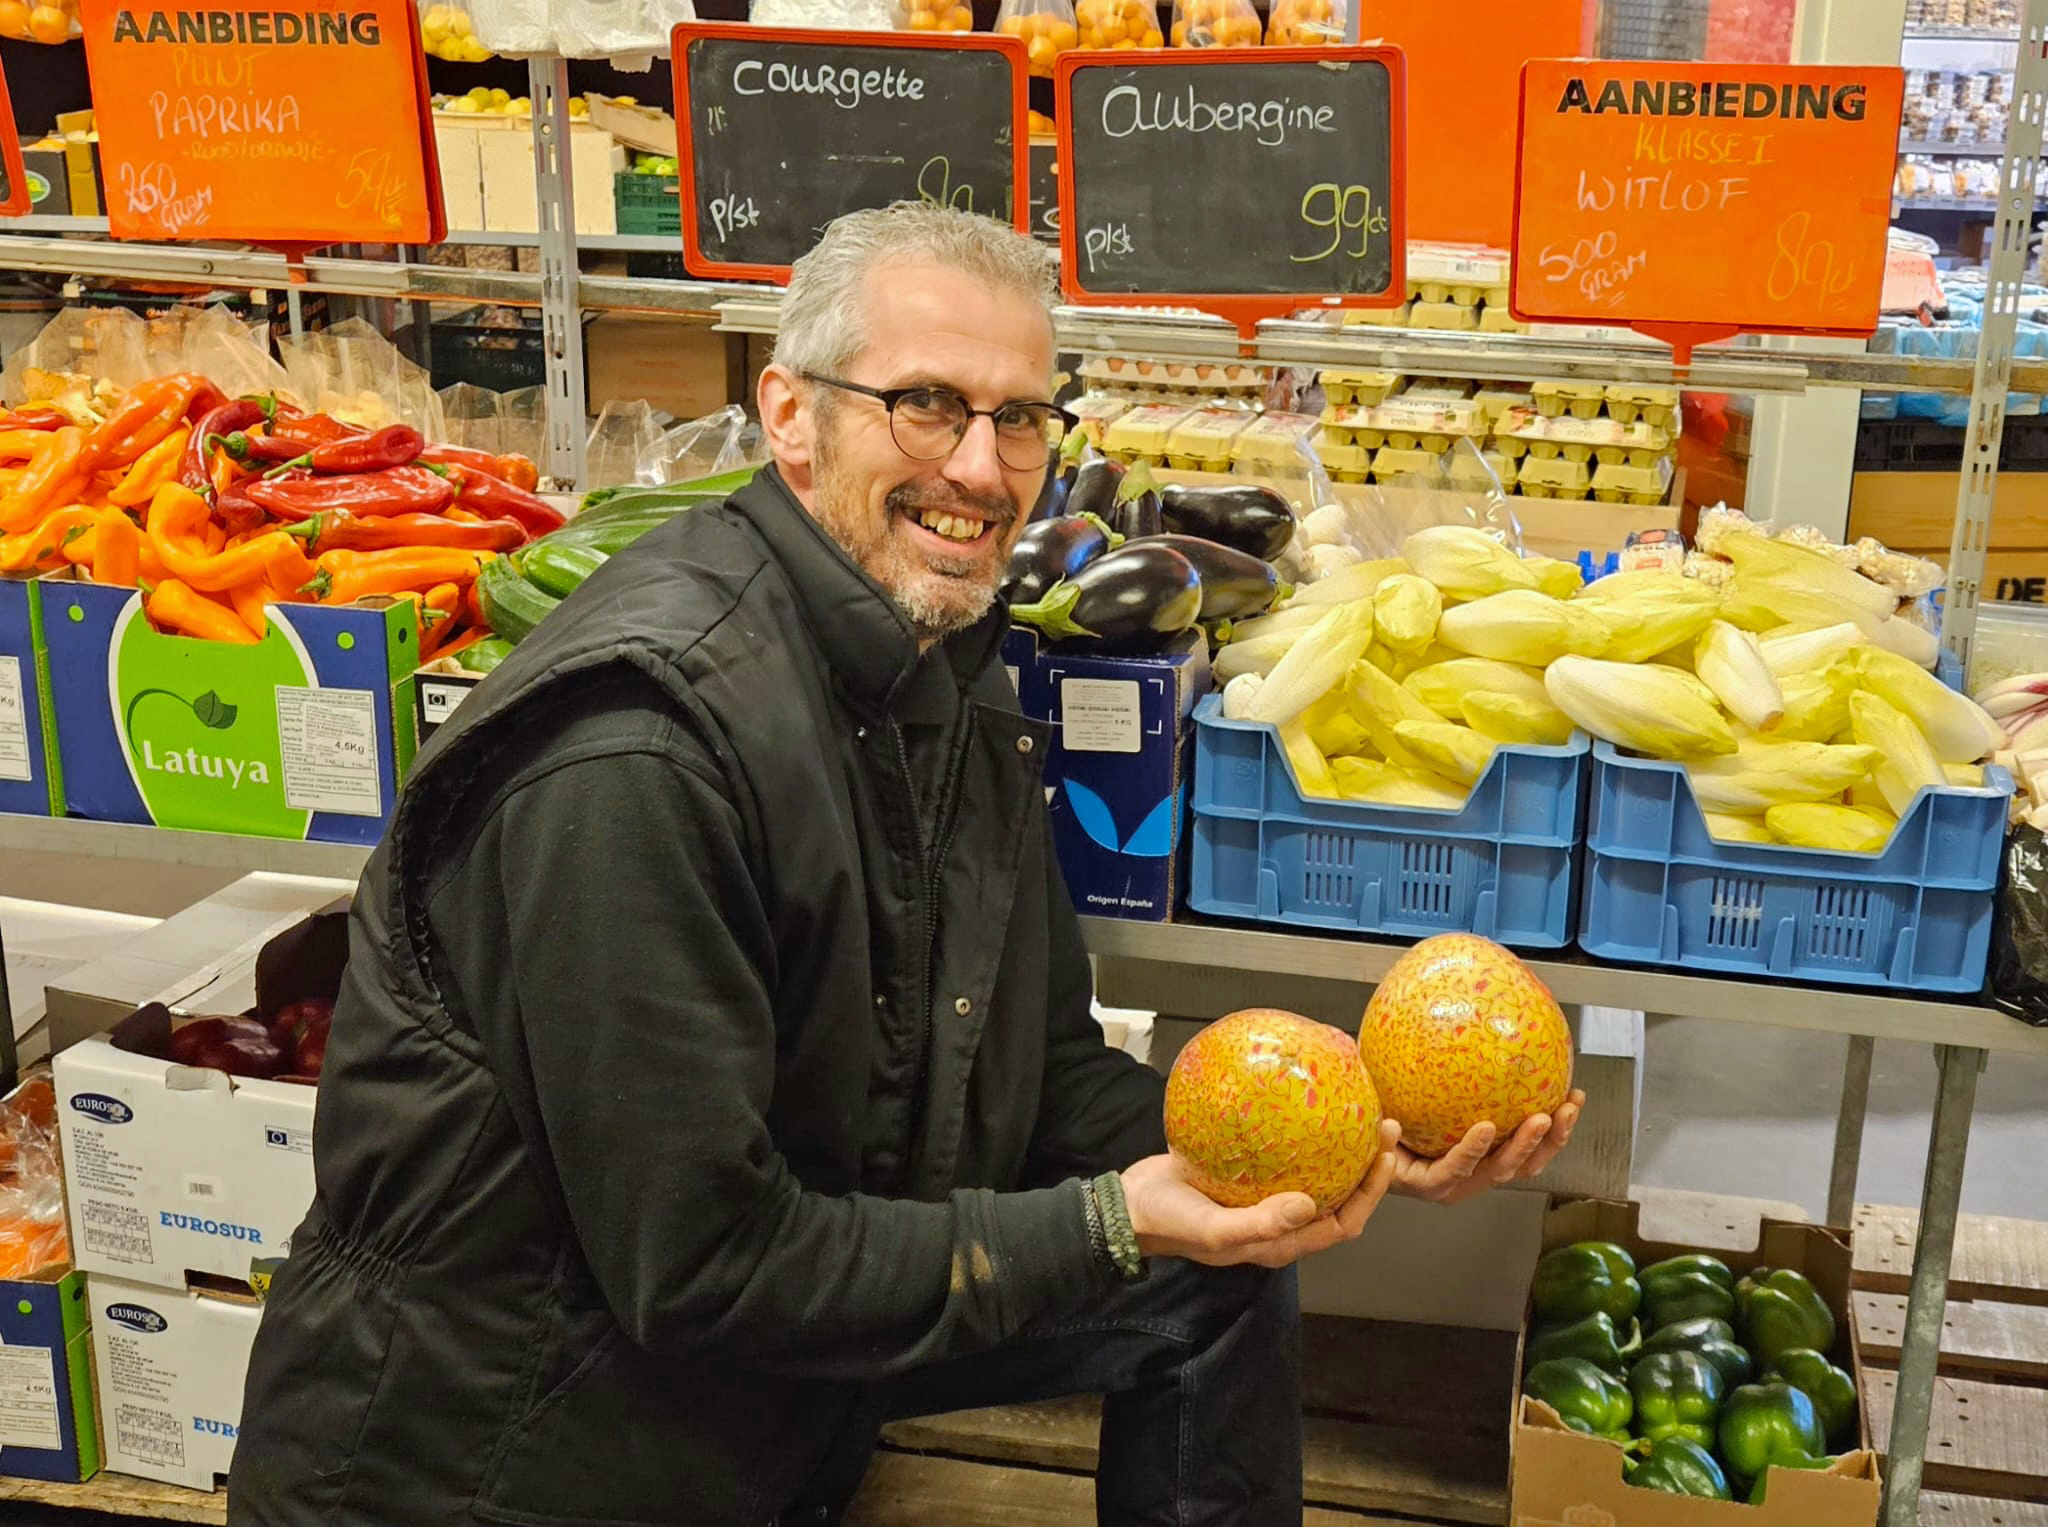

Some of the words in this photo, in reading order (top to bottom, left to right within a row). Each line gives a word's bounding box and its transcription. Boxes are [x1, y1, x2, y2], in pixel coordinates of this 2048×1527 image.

[113, 10, 380, 46] AANBIEDING
[150, 89, 300, 140] PAPRIKA
[1556, 78, 1867, 121] AANBIEDING
[1538, 231, 1617, 282] 500
[1579, 250, 1647, 302] GRAM
[143, 740, 270, 789] Latuya
[1087, 894, 1118, 905] Origen
[160, 1211, 263, 1244] EUROSUR
